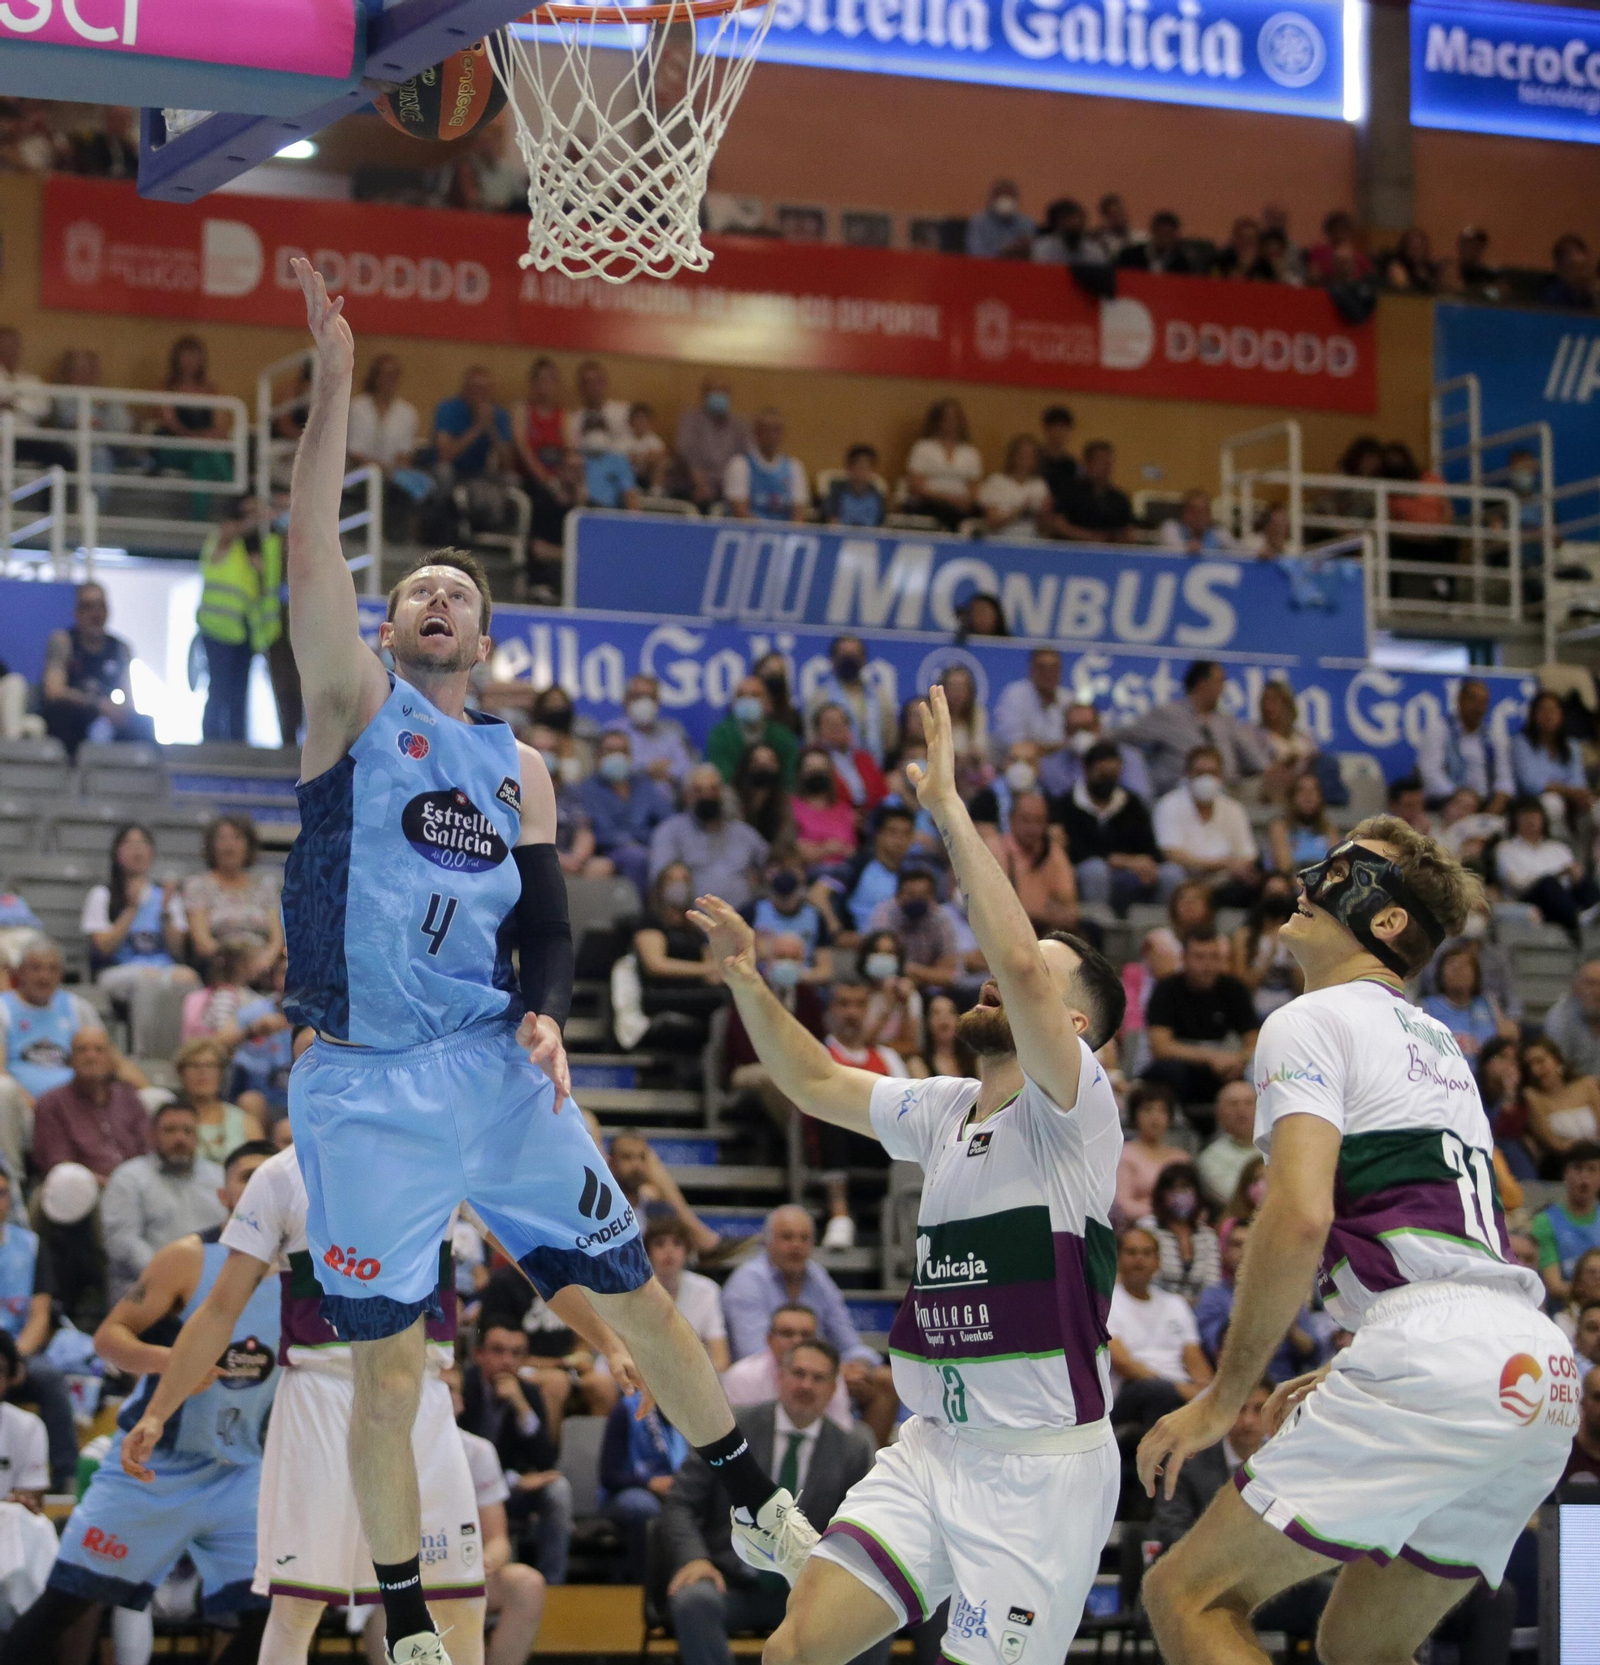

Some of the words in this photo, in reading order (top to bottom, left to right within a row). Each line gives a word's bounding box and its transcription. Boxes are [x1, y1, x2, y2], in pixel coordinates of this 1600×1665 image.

[738, 0, 992, 51] strella
[449, 55, 476, 127] endesa
[825, 538, 1242, 648] MONBUS
[420, 800, 498, 836] Estrella
[423, 820, 493, 857] Galicia
[420, 892, 459, 957] 4
[1441, 1131, 1509, 1264] 21
[926, 1251, 988, 1281] Unicaja
[959, 1328, 994, 1343] Eventos
[1549, 1383, 1573, 1404] DEL
[386, 1574, 419, 1591] WIBO
[1009, 1612, 1028, 1624] acb
